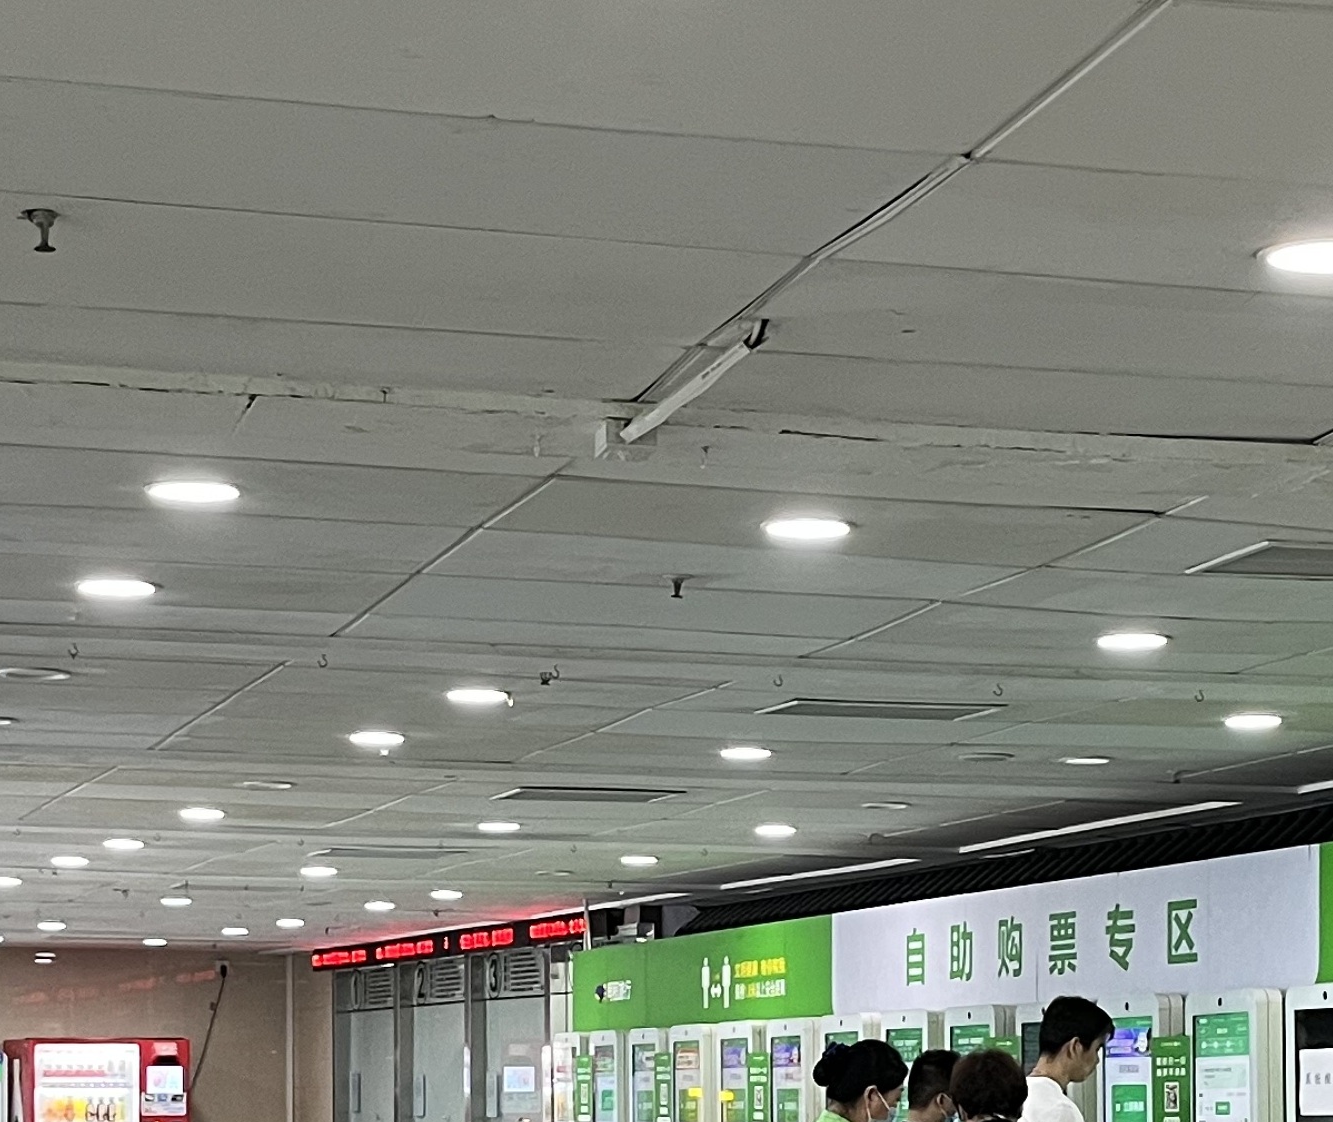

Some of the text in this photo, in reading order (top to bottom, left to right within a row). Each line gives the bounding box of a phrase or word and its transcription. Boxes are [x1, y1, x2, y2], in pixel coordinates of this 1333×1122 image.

[906, 898, 1199, 987] 自助购票专区
